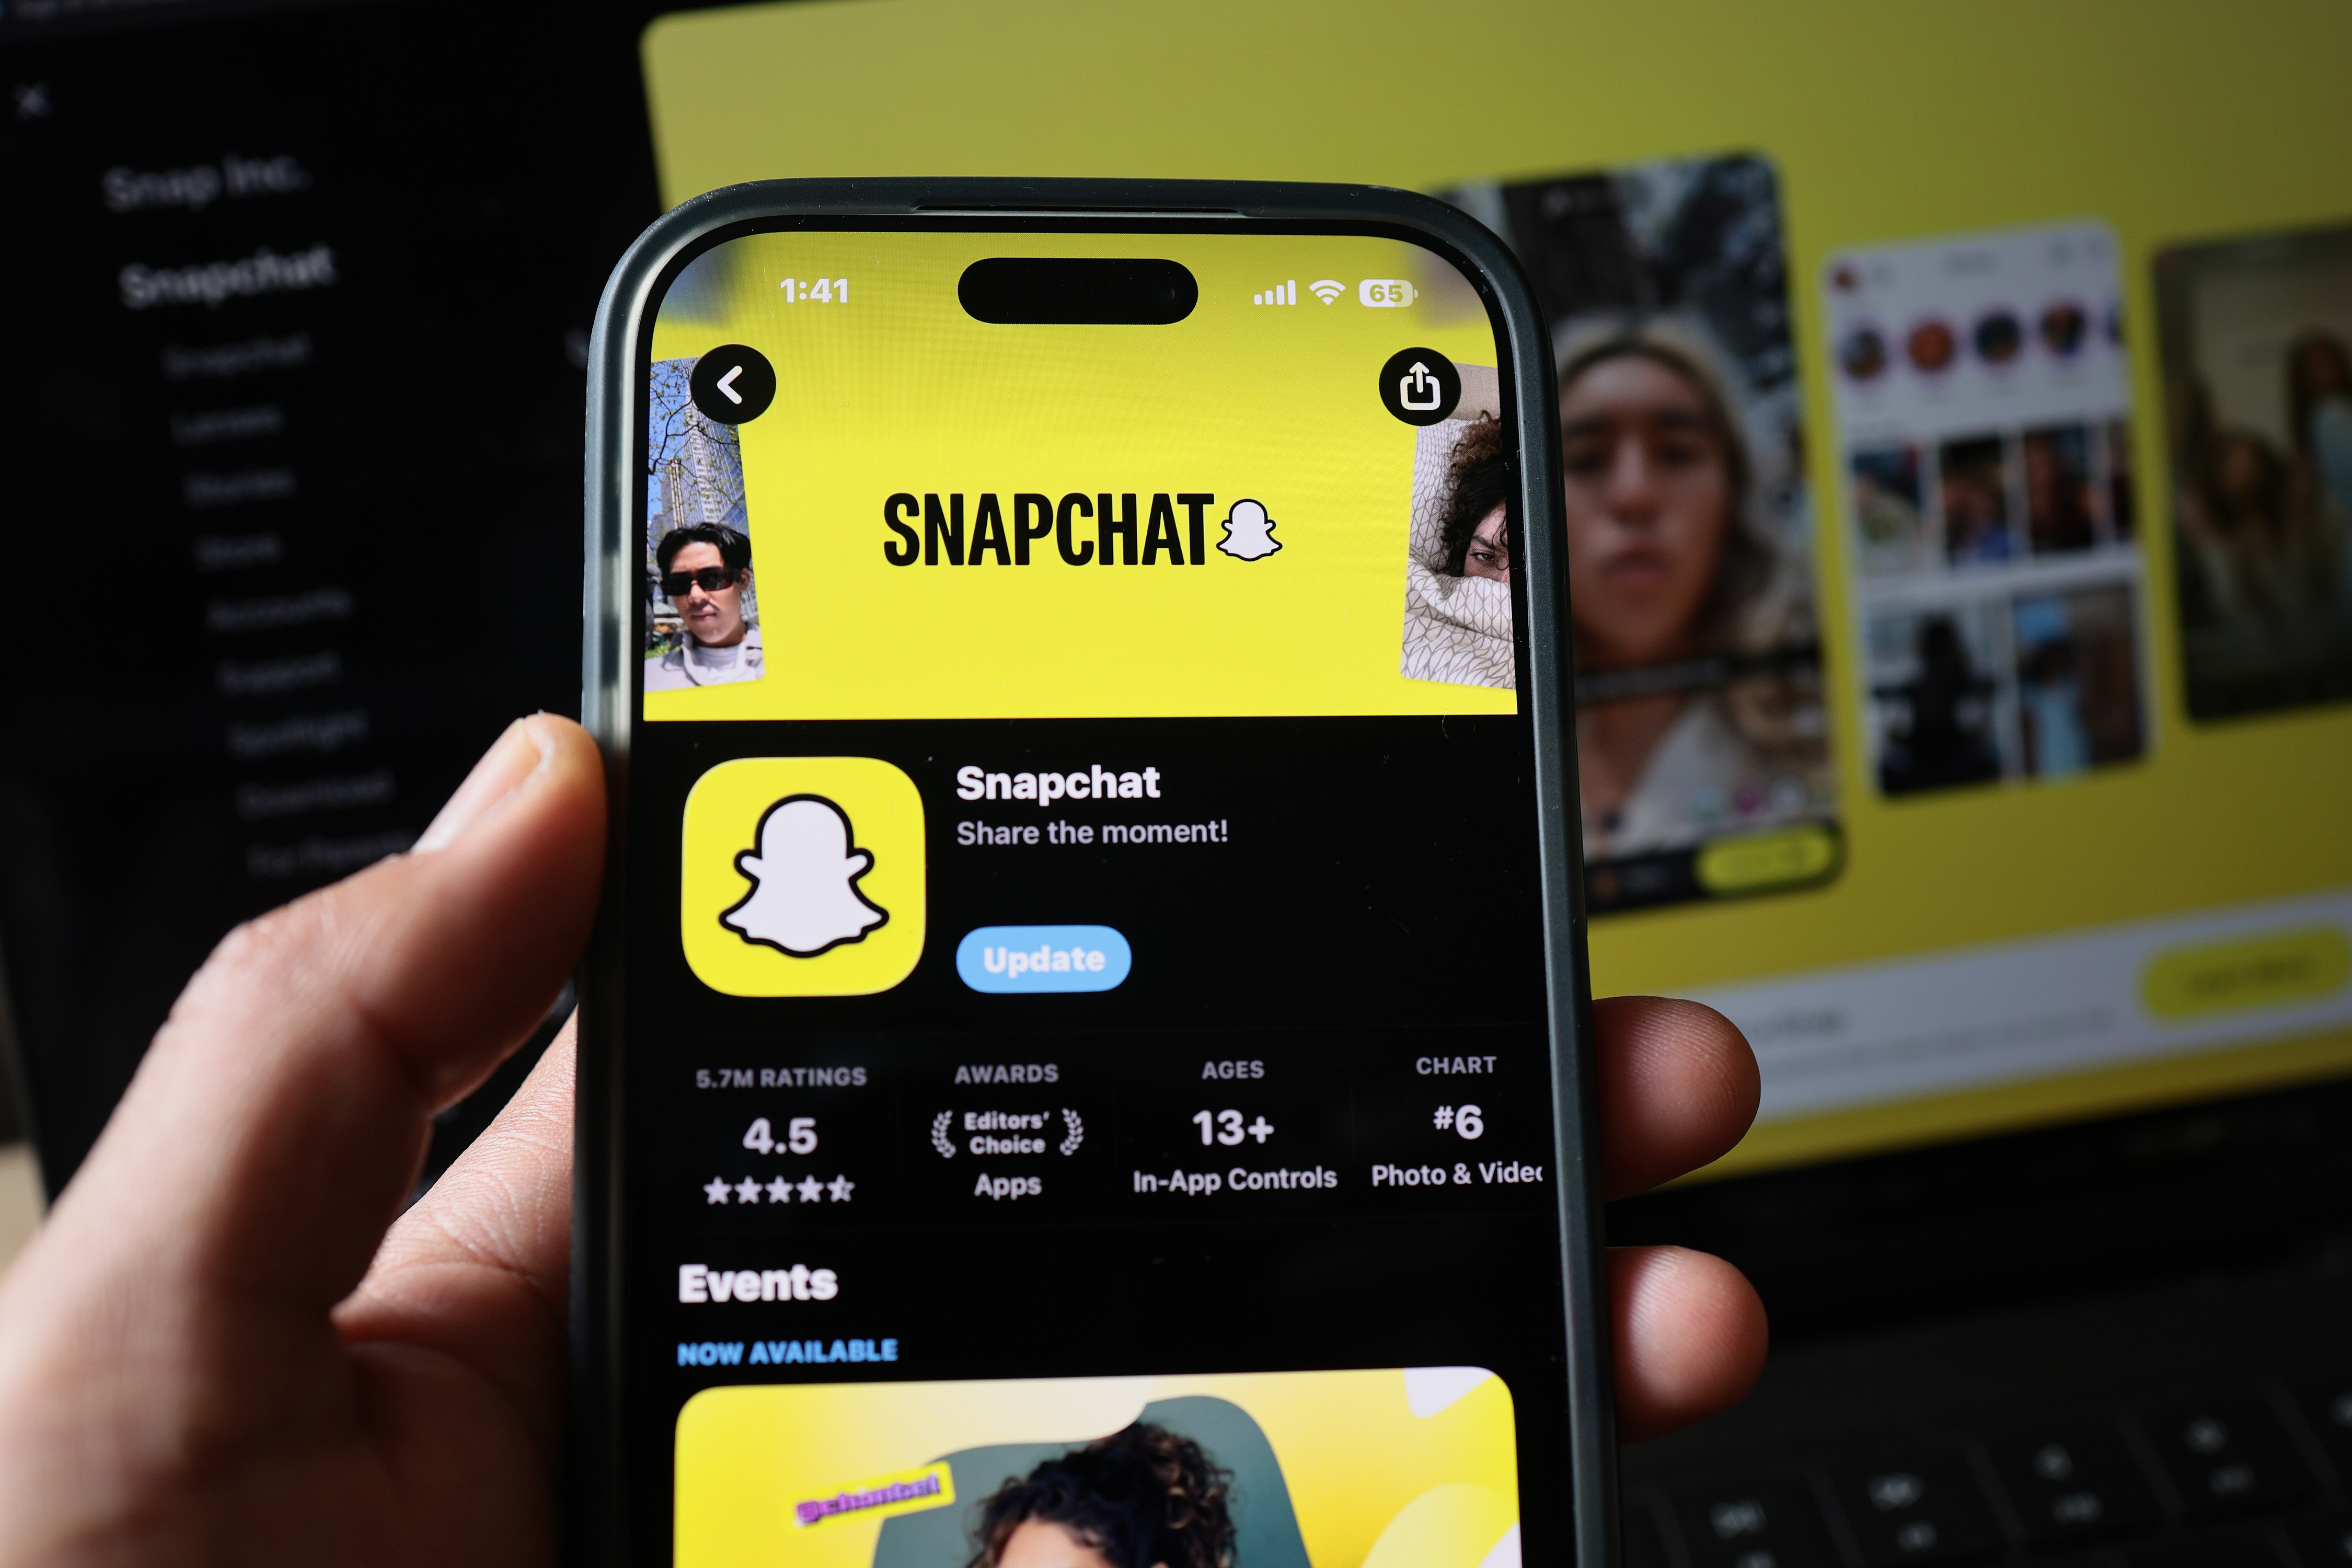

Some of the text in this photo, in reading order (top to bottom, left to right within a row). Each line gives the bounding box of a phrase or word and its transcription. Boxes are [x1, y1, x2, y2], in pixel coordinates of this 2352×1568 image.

[121, 247, 333, 306] Snapchat
[780, 278, 848, 303] 1:41
[1369, 284, 1404, 303] 65
[883, 492, 1215, 567] SNAPCHAT
[957, 765, 1160, 806] Snapchat
[958, 820, 1228, 845] Share the moment!
[984, 945, 1105, 978] Update
[696, 1067, 867, 1088] 5.7M RATINGS
[955, 1064, 1058, 1083] AWARDS
[1202, 1060, 1264, 1079] AGES
[1416, 1056, 1496, 1075] CHART
[1193, 1110, 1274, 1145] 13+
[1433, 1104, 1483, 1139] #6
[743, 1117, 817, 1154] 4.5
[970, 1135, 1045, 1155] Choice
[974, 1173, 1042, 1200] Apps
[1134, 1166, 1338, 1196] In-App Controls
[1372, 1164, 1446, 1186] Photo
[1453, 1163, 1471, 1184] &
[679, 1264, 838, 1302] Events
[677, 1339, 897, 1366] NOW AVAILABLE
